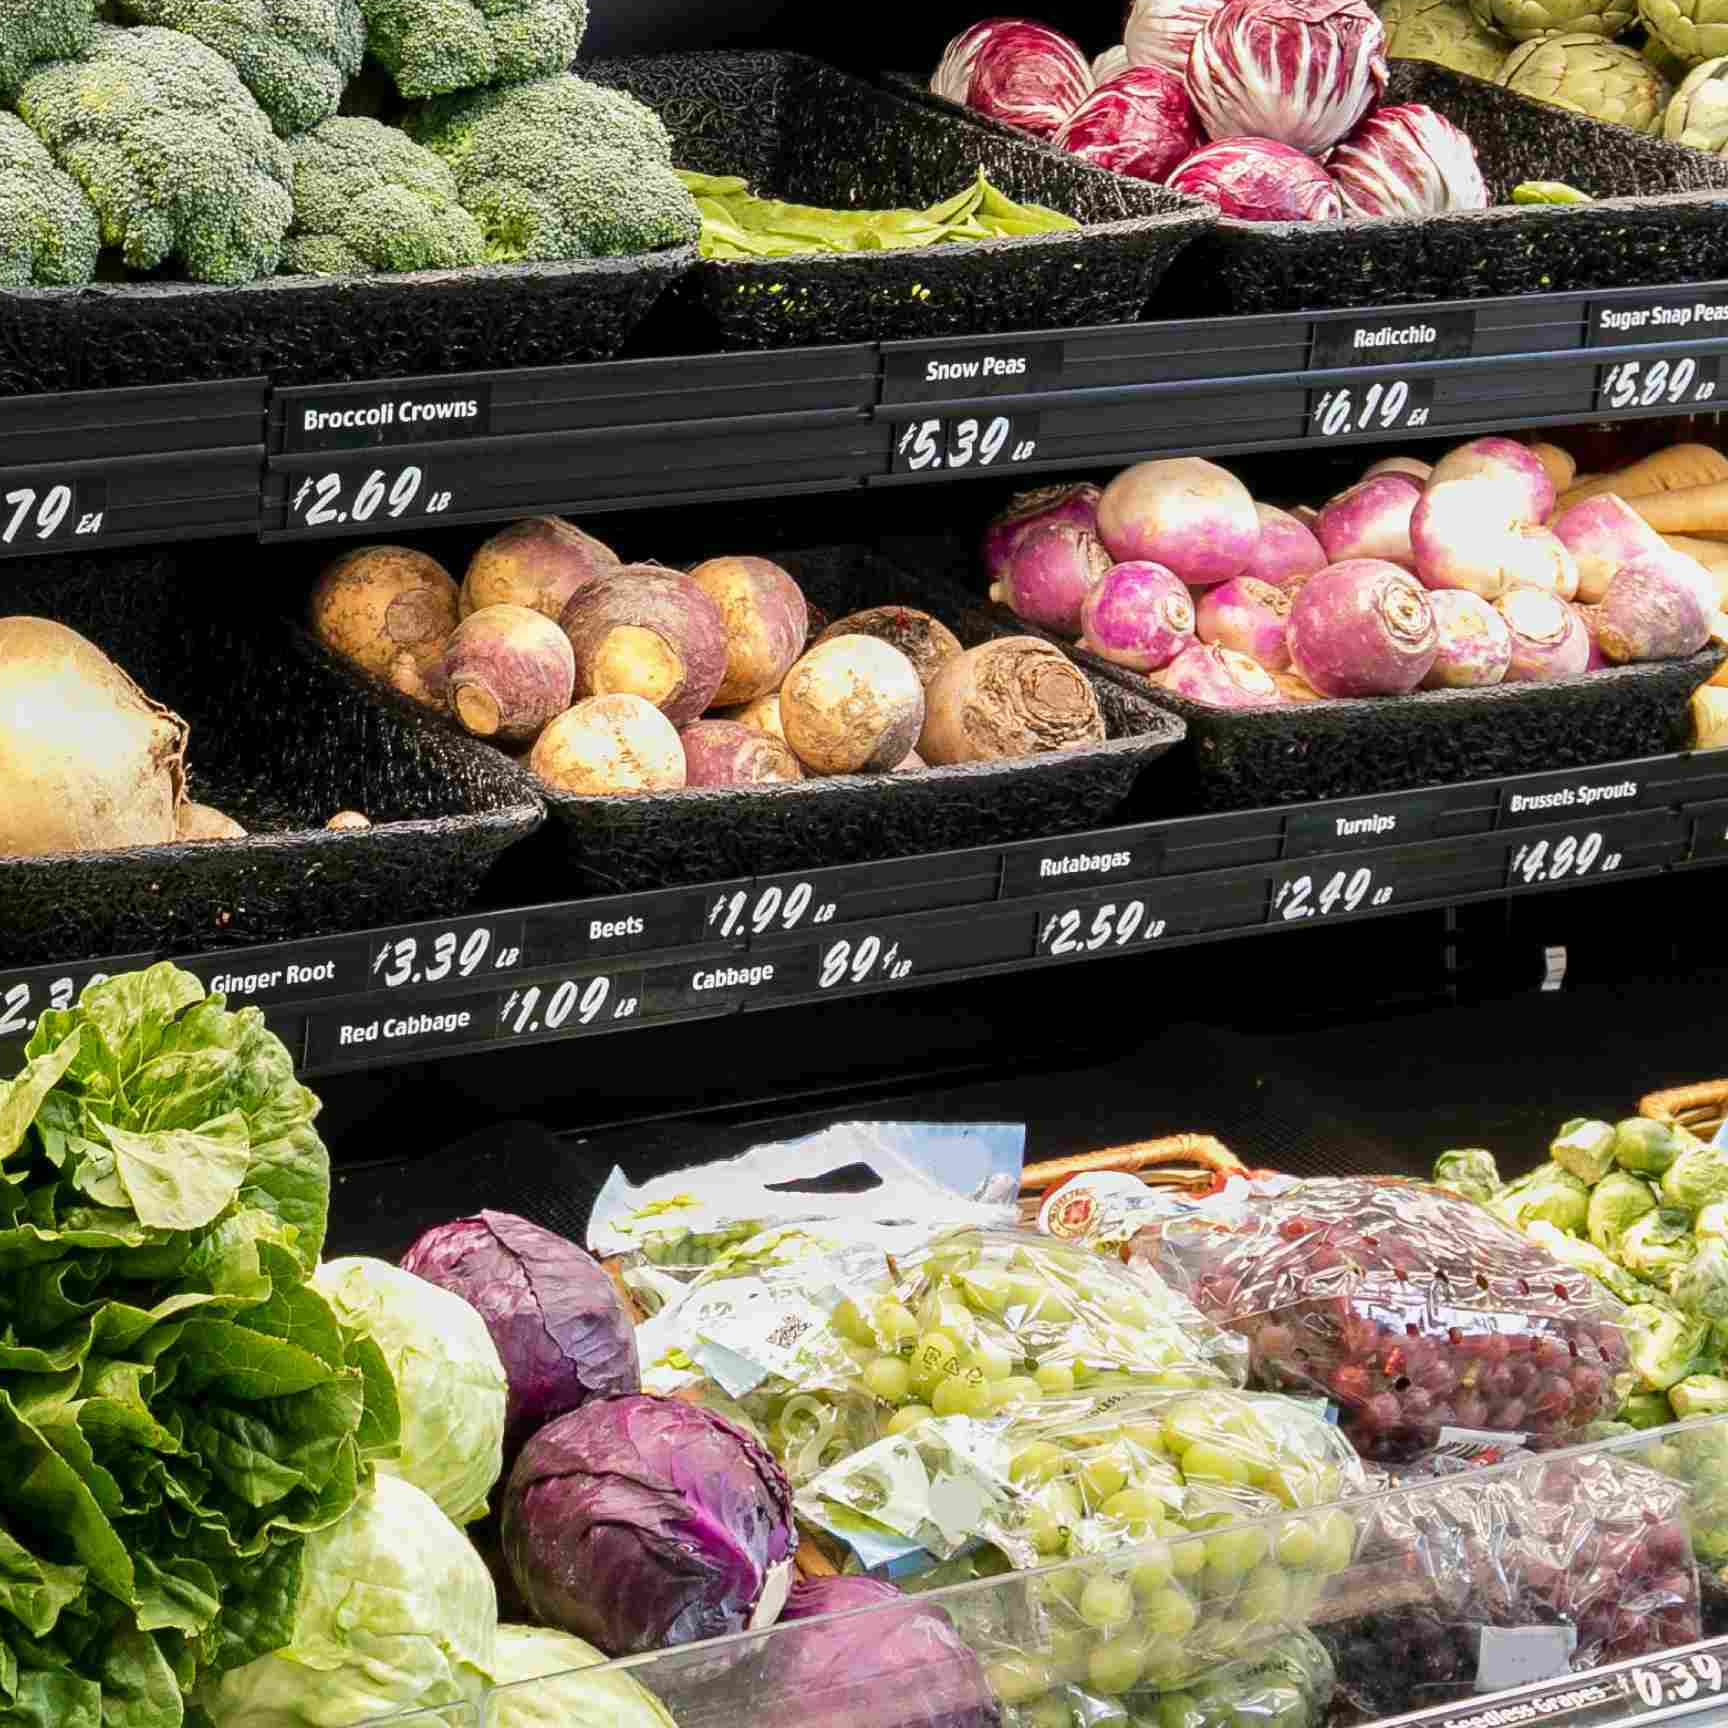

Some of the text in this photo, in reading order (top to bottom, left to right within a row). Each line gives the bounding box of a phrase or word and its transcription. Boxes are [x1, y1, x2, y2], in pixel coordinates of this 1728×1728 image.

[1354, 325, 1436, 348] Radicchio
[1600, 309, 1647, 333] Sugar
[1651, 306, 1689, 326] Snap
[926, 355, 1028, 381] Snow Peas
[1604, 358, 1695, 407] $5.89
[304, 400, 477, 430] Broccoli Crowns
[1315, 381, 1408, 435] $6.19
[899, 417, 1009, 469] $5.39
[293, 467, 421, 525] $2.69
[1510, 781, 1637, 812] Brussels Sprouts
[1336, 814, 1395, 836] Turnips
[1040, 852, 1130, 877] Rutabagas
[1512, 833, 1602, 882] $4.89
[709, 883, 812, 936] $1.99
[1275, 868, 1371, 920] $2.49
[590, 916, 643, 939] Beets
[1042, 901, 1144, 955] $2.59
[373, 928, 490, 986] $3.39
[211, 961, 335, 1001] Ginger Root
[693, 965, 773, 990] Cabbage
[501, 976, 609, 1033] $1.09
[340, 1012, 470, 1044] Red Cabbage
[1536, 1682, 1608, 1716] Grapes
